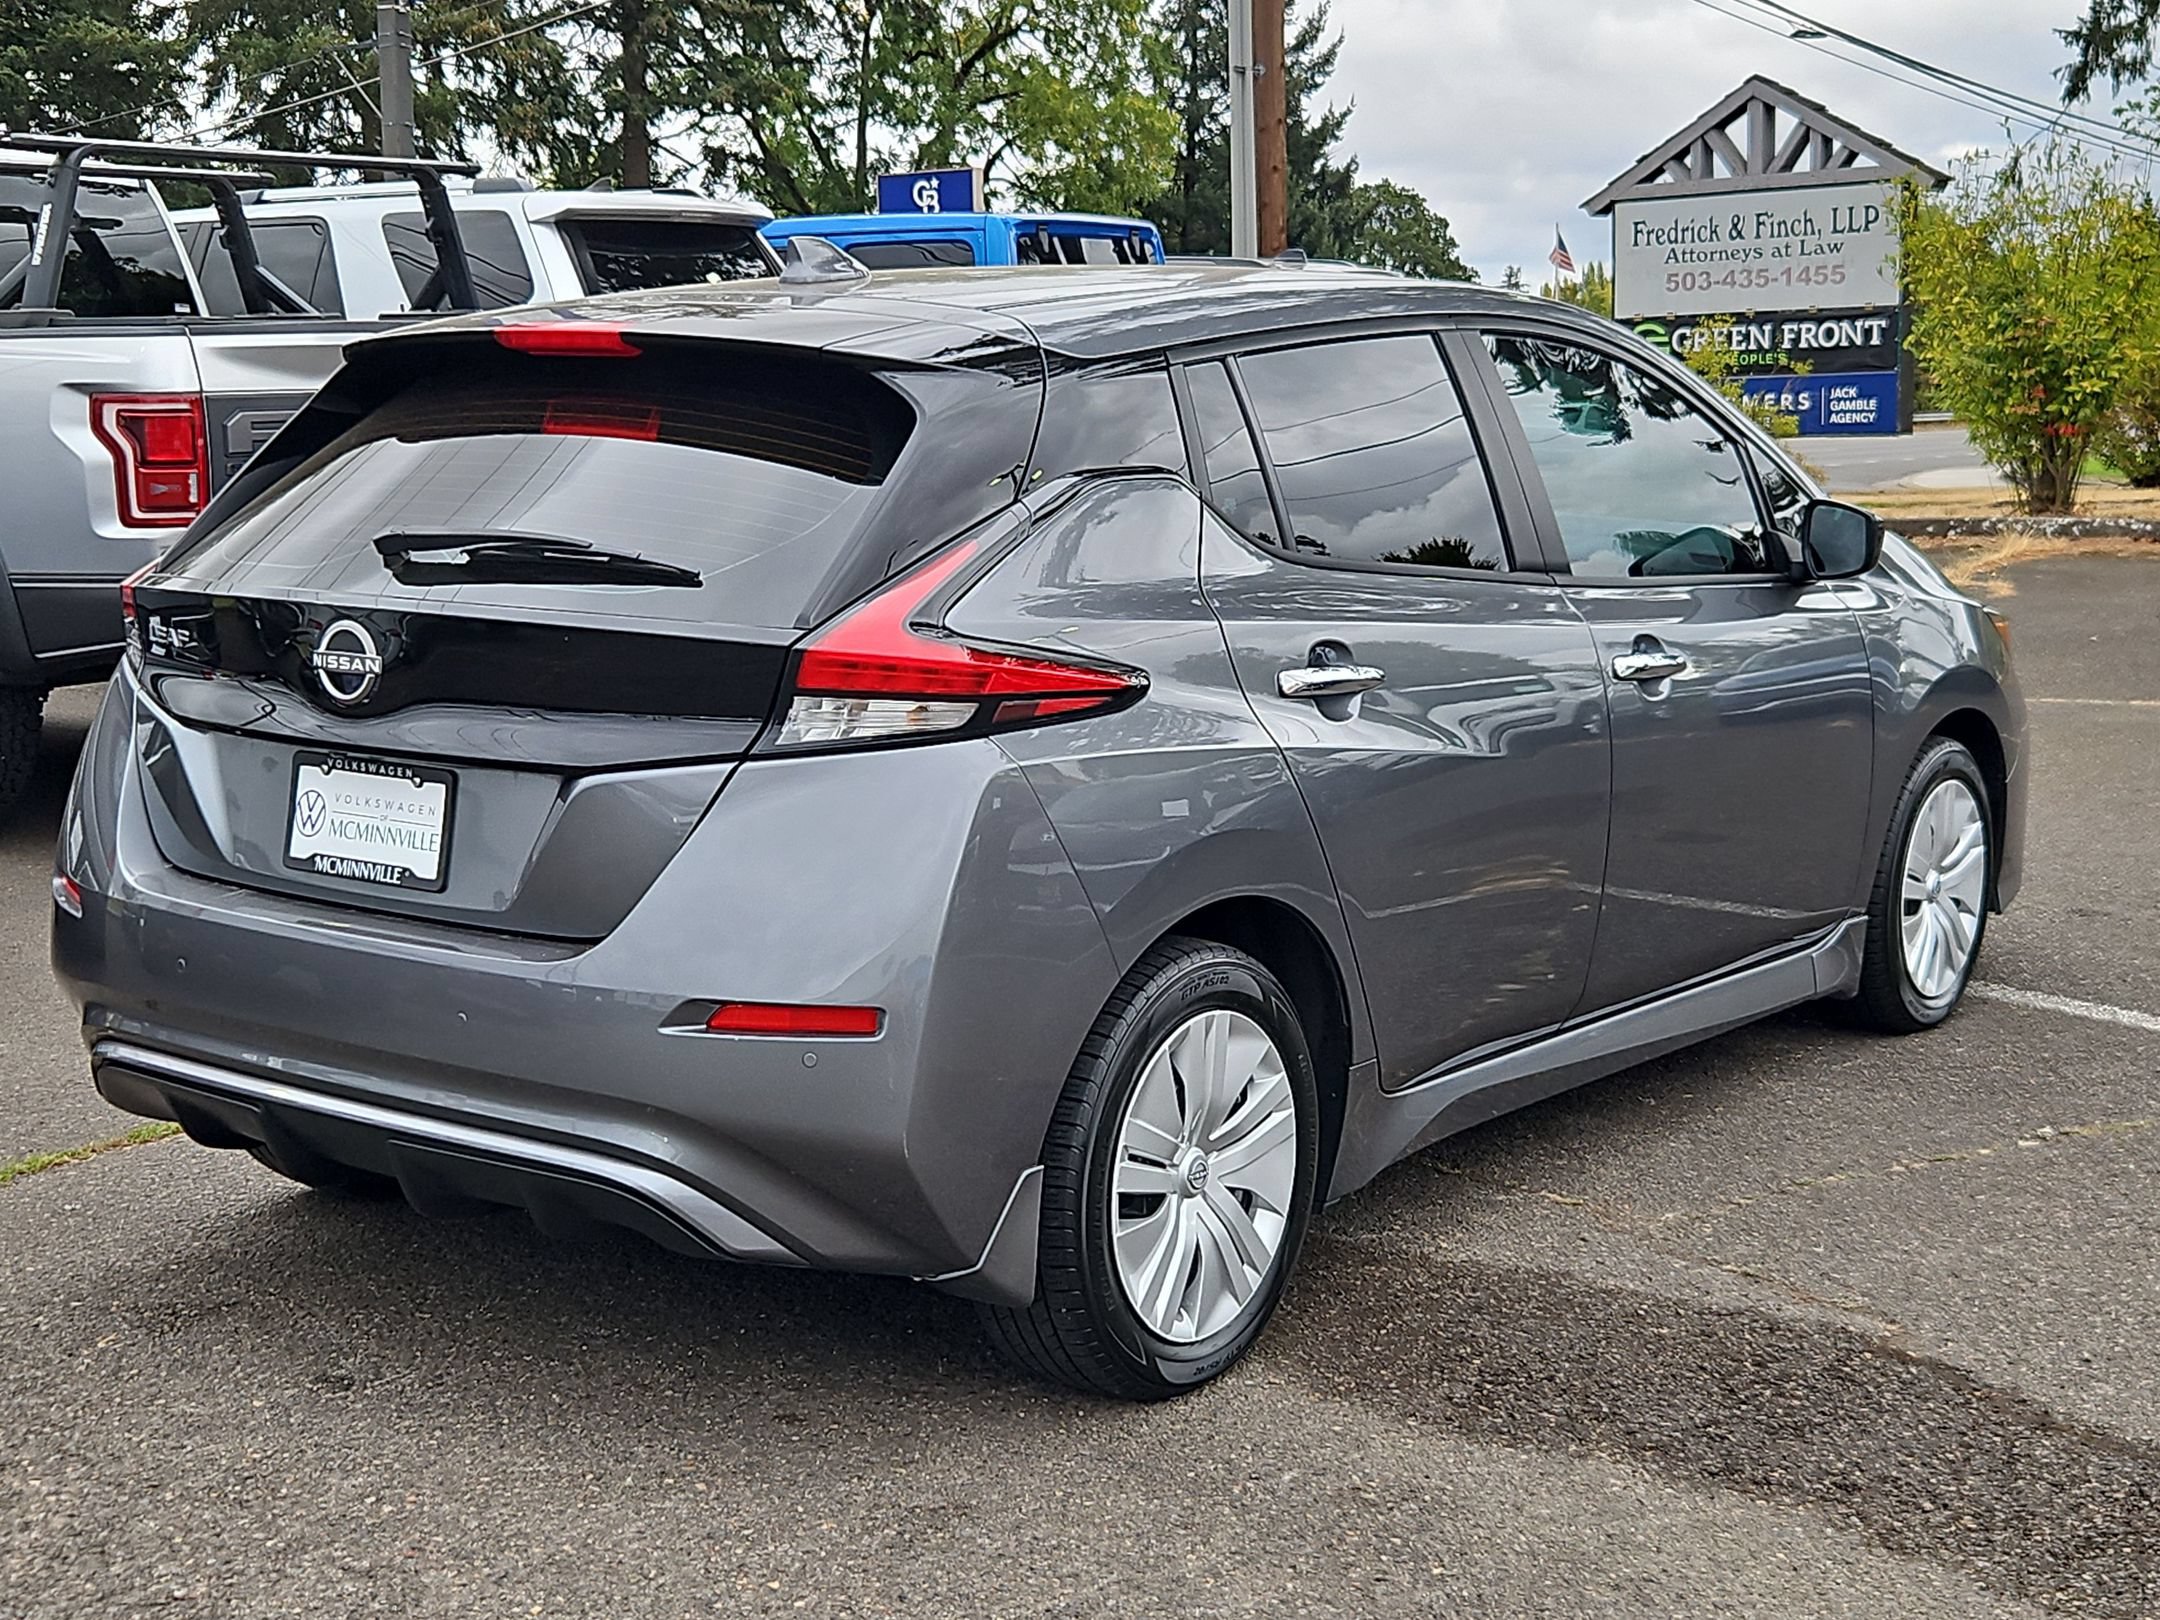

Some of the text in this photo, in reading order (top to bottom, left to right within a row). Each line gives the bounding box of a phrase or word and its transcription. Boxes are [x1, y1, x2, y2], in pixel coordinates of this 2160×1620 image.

[1632, 205, 1879, 247] Fredrick & Finch, LLP
[1664, 239, 1844, 264] Attorneys at Law
[1665, 264, 1846, 292] 503-435-1455
[1671, 318, 1887, 354] GREEN FRONT
[1730, 352, 1788, 366] EOPLE'S
[1741, 391, 1812, 411] MERS
[1829, 386, 1858, 398] JACK
[1829, 399, 1877, 411] GAMBLE
[1828, 411, 1877, 424] AGENCY
[313, 652, 381, 673] NISSAN
[327, 758, 413, 778] VOLKSWAGEN
[335, 793, 436, 816] VOLKSWAGEN
[328, 818, 440, 852] MCMINNVILLE
[314, 855, 403, 884] MCMINNVILLE
